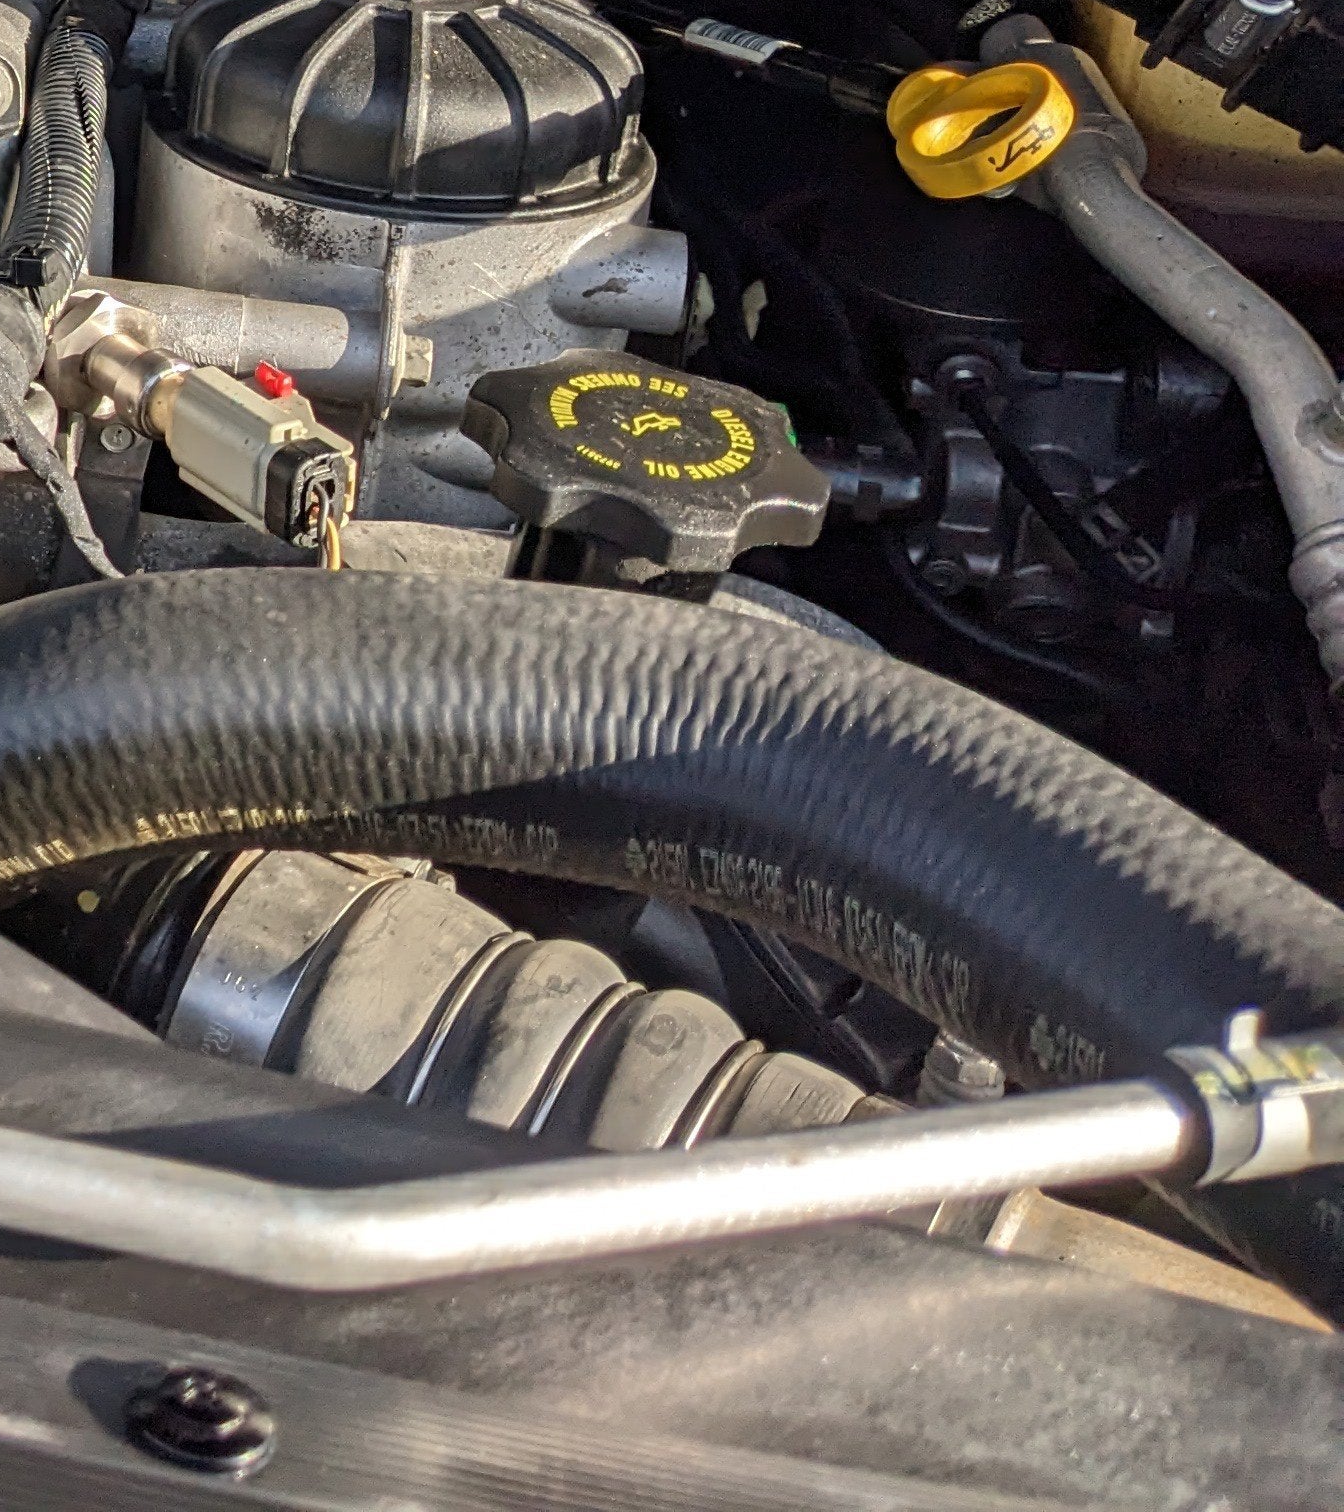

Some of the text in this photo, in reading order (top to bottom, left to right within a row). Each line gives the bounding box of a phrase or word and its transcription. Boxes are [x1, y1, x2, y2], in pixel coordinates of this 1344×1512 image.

[549, 385, 579, 430] MANUAL
[648, 377, 689, 399] SEE
[642, 407, 755, 480] DIESEL ENGINE OIL
